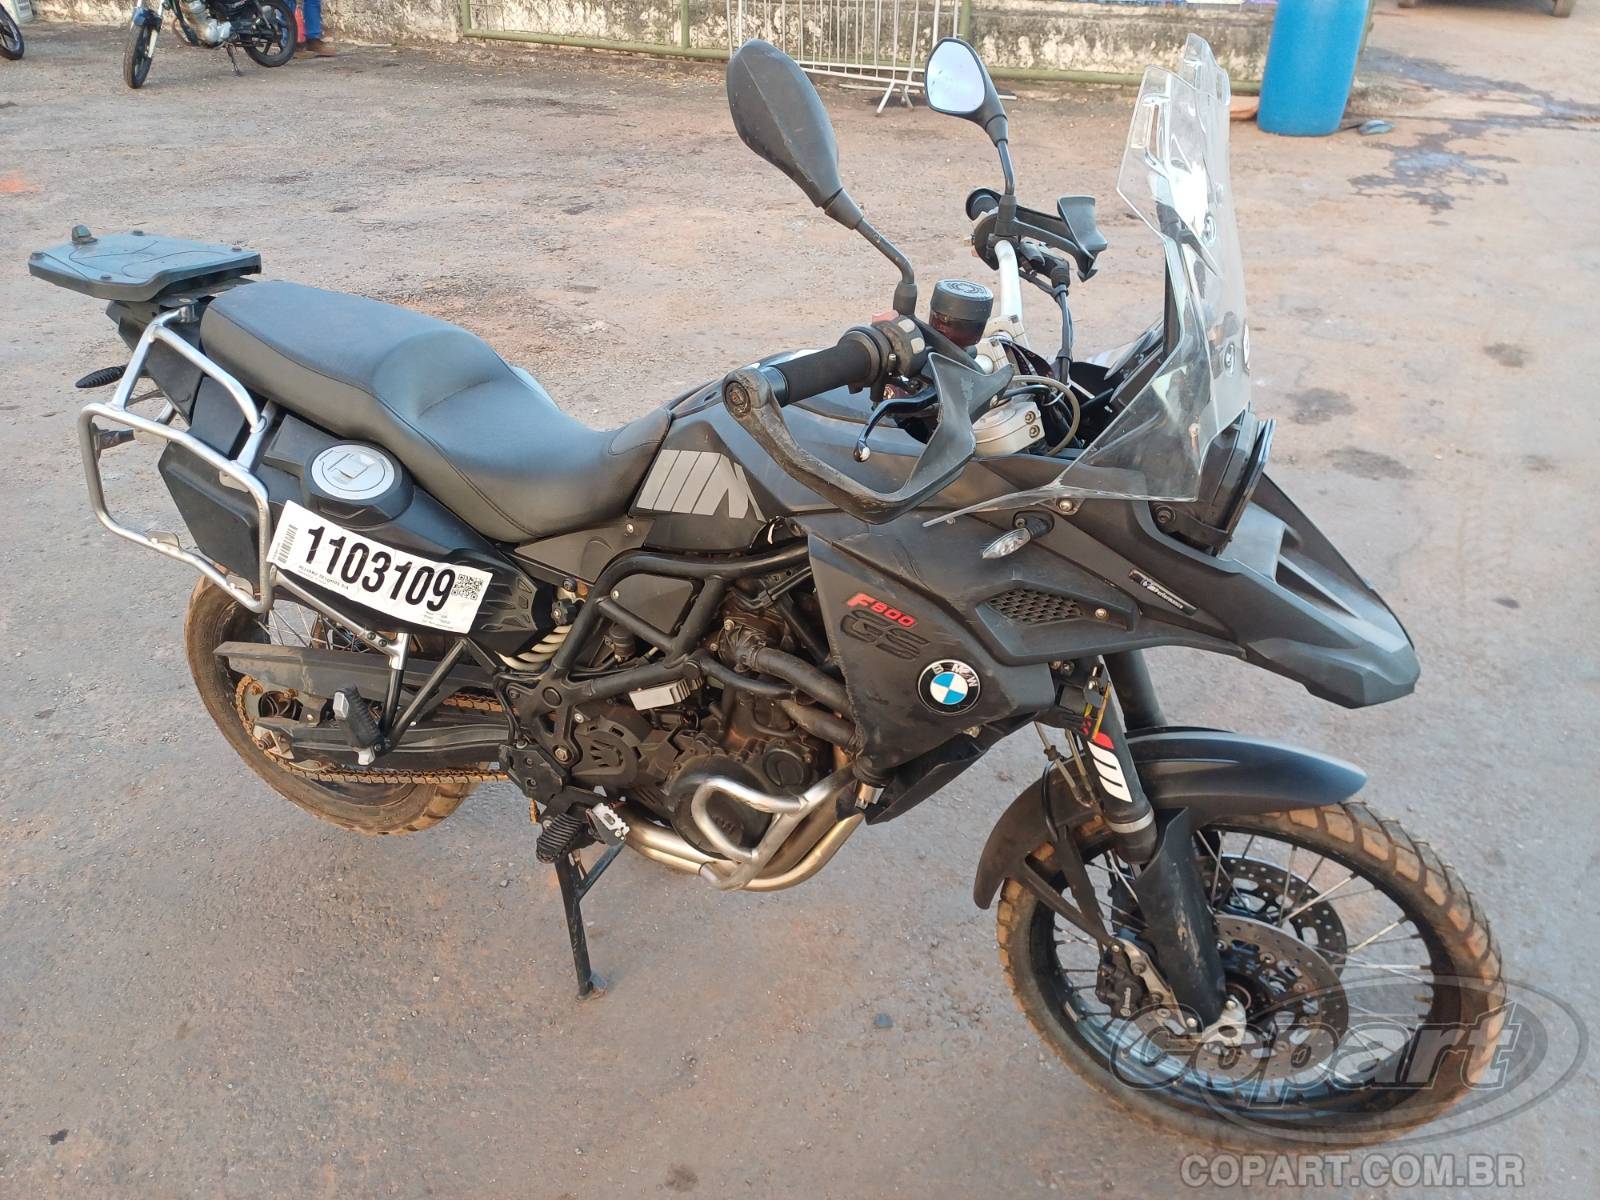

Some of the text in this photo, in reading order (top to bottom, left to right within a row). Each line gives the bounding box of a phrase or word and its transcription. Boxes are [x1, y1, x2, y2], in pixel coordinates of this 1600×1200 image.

[306, 526, 456, 612] 1103109
[847, 593, 917, 629] F800
[840, 609, 931, 661] GS
[931, 662, 979, 688] BMW
